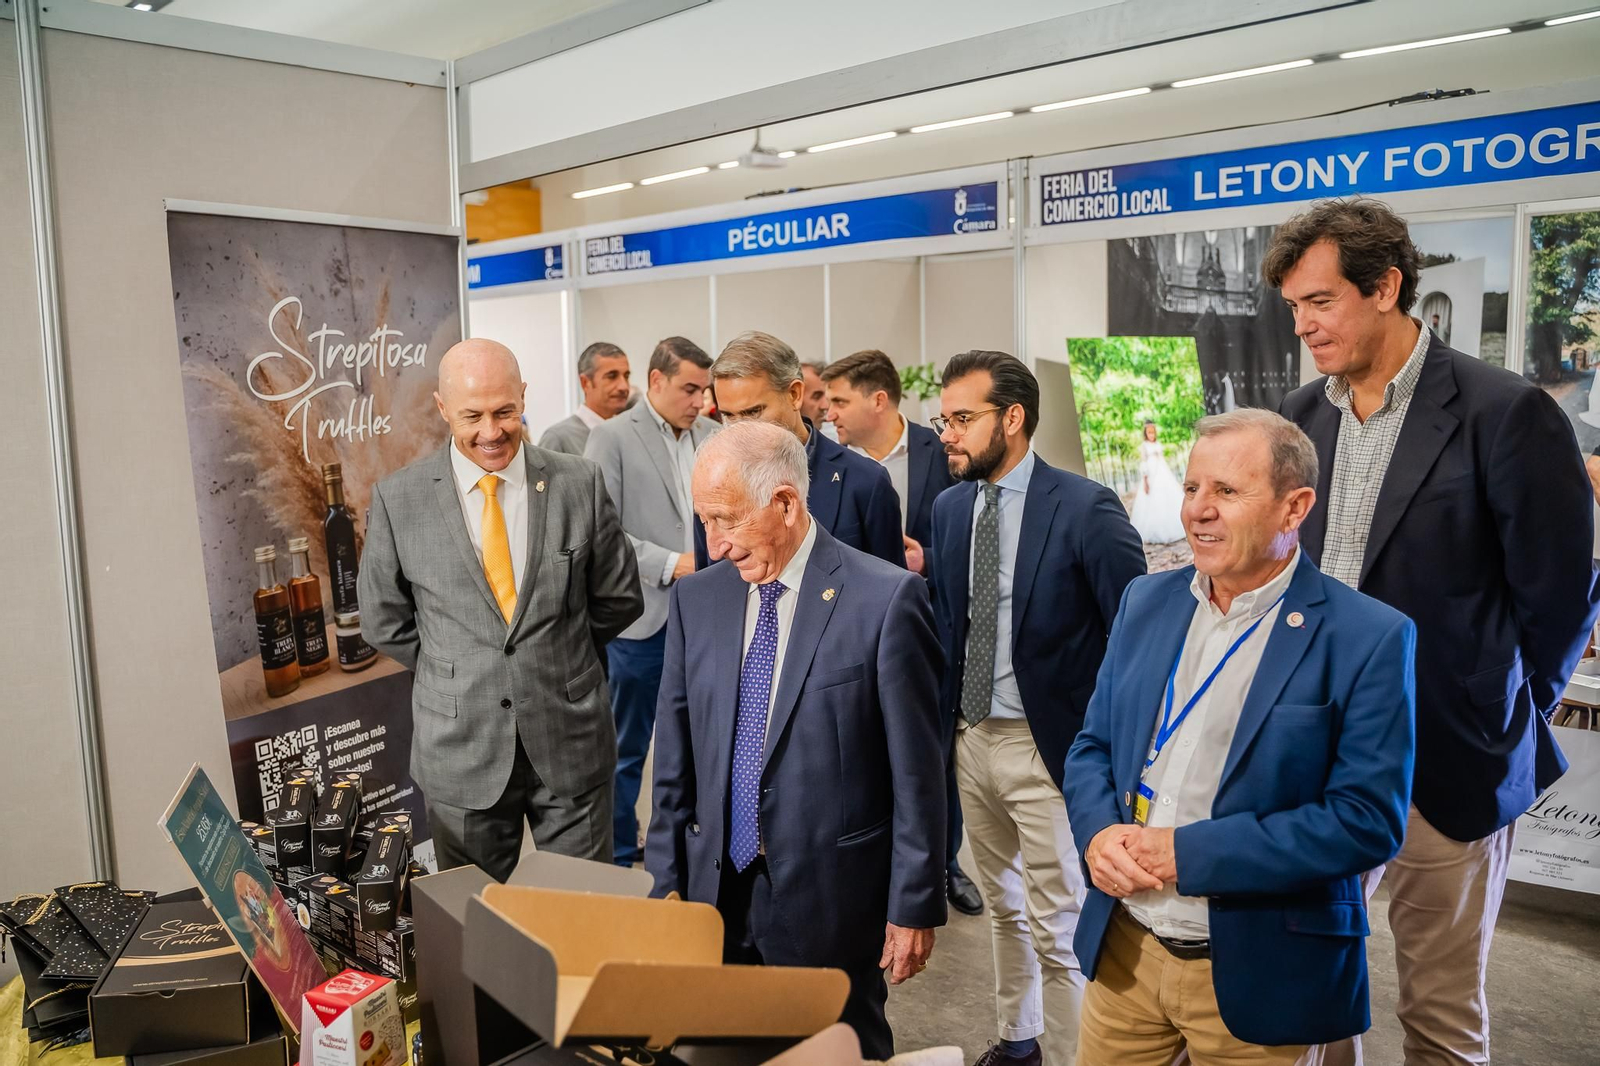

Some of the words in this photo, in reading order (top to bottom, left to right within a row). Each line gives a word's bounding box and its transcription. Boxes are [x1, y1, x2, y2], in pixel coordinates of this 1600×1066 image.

[1193, 150, 1371, 201] LETONY
[1384, 121, 1600, 181] FOTOGR
[1043, 173, 1085, 199] FERIA
[1088, 169, 1117, 194] DEL
[1043, 193, 1119, 223] COMERCIO
[1121, 187, 1172, 216] LOCAL
[727, 212, 850, 252] PÉCULIAR
[246, 296, 427, 401] Strepitosa
[284, 381, 392, 463] Truffles
[324, 719, 361, 741] ¡Escanea
[325, 744, 332, 756] y
[333, 732, 370, 751] descubre
[370, 725, 387, 738] más
[328, 753, 352, 769] sobre
[352, 741, 385, 760] nuestros
[140, 919, 225, 940] Strepi
